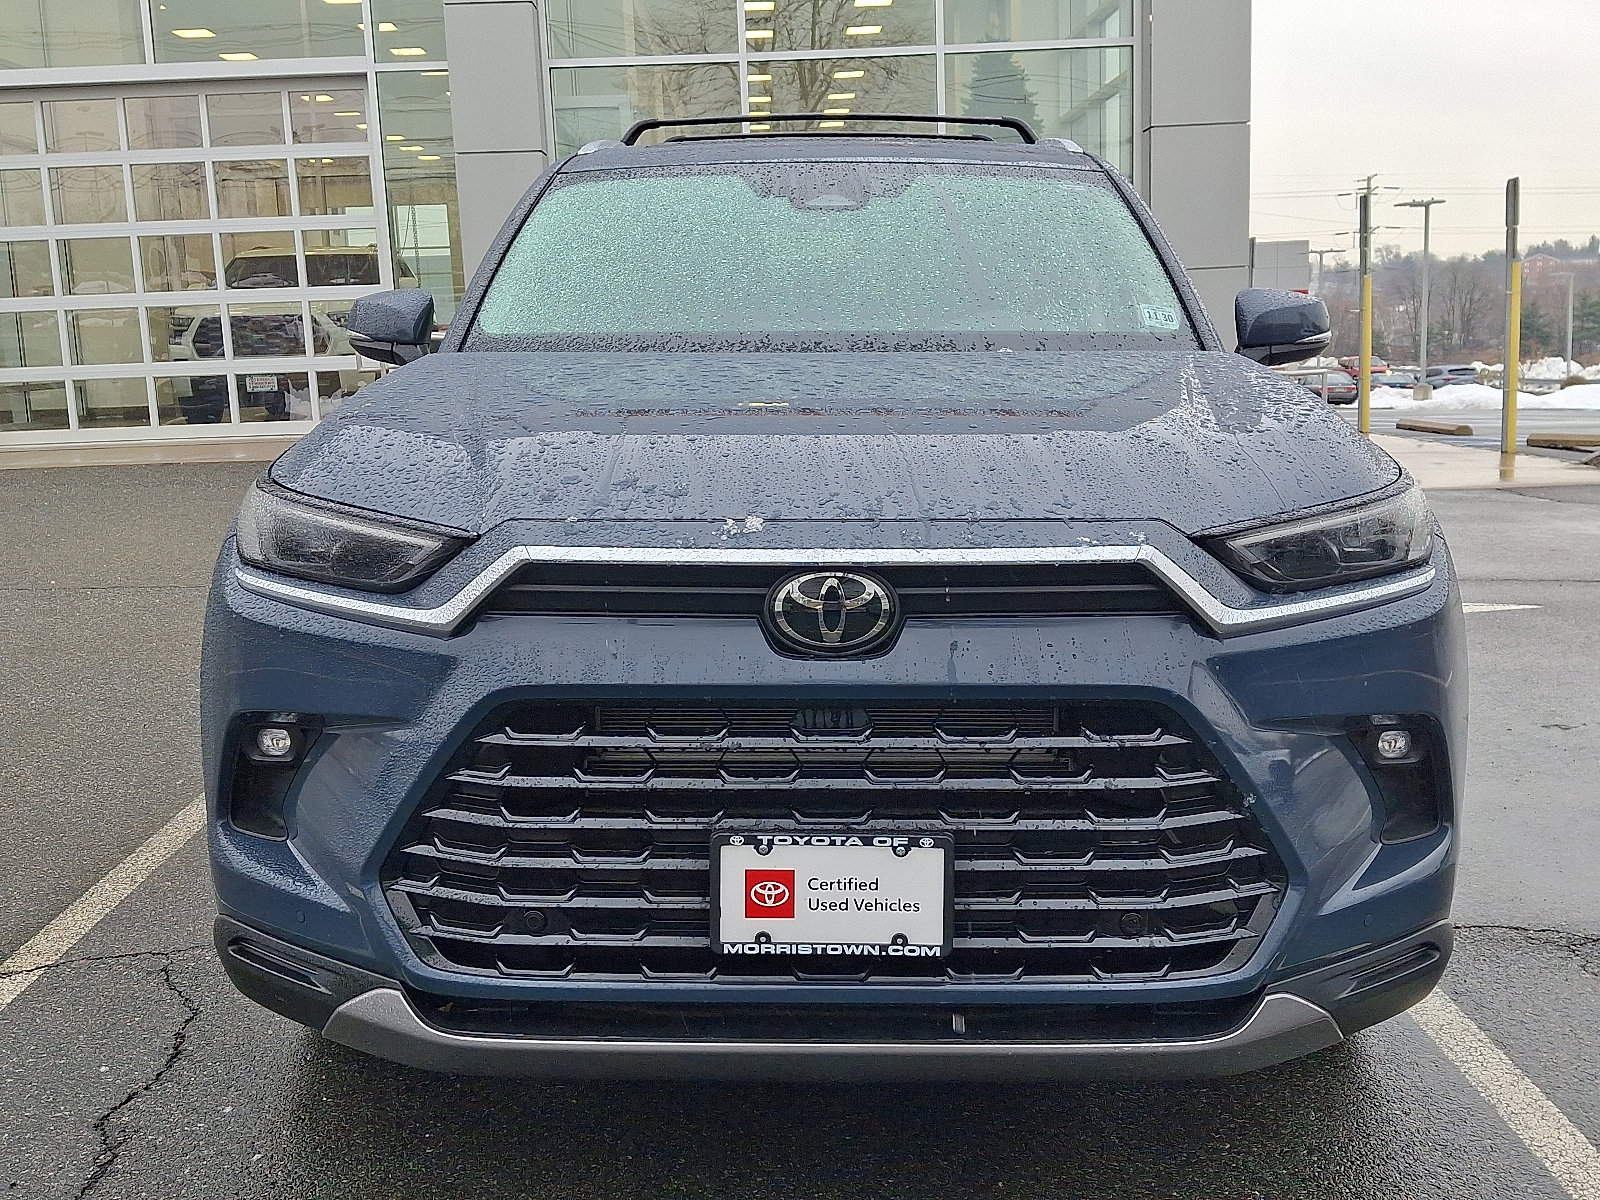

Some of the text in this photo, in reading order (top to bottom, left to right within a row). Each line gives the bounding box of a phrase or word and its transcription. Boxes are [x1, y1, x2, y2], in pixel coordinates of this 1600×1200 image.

[1162, 312, 1174, 323] 30
[757, 835, 909, 847] TOYOTA OF
[807, 877, 879, 891] Certified
[808, 897, 920, 912] Used Vehicles
[723, 943, 941, 957] MORRISTOWN.COM
